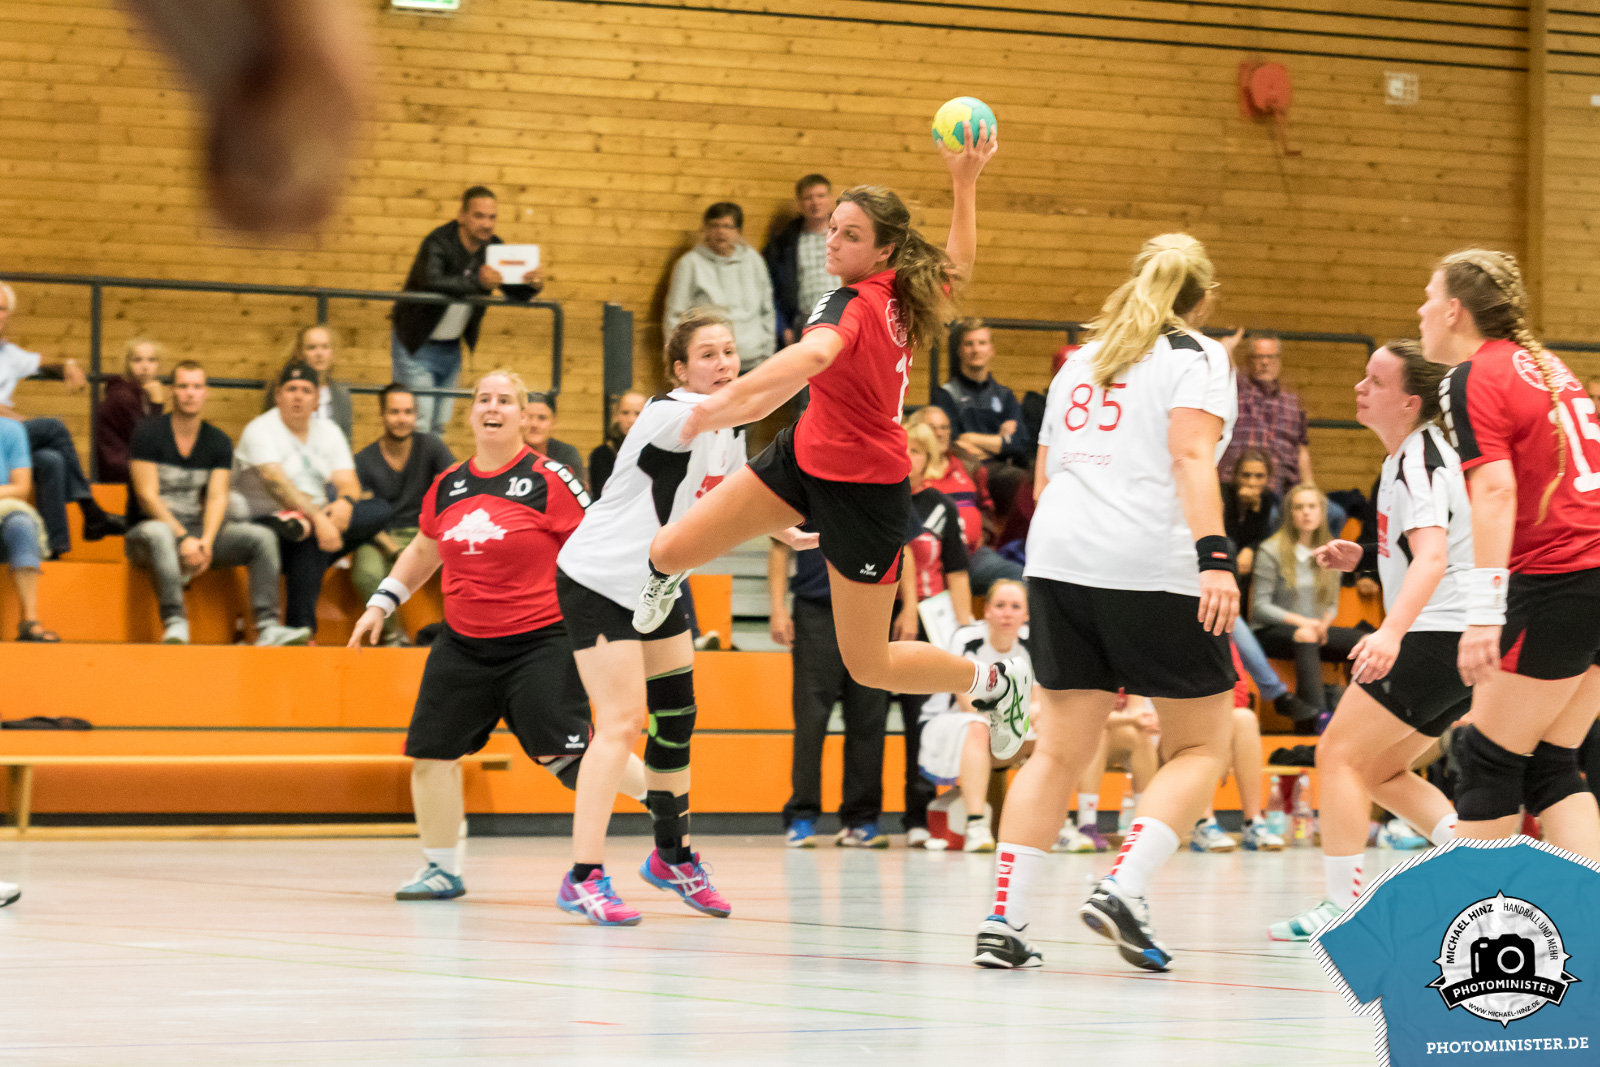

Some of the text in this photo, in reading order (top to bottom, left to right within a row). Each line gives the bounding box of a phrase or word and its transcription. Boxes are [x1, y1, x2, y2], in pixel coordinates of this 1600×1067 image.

[892, 352, 913, 425] 1
[1064, 383, 1127, 432] 85
[1548, 397, 1600, 493] 15
[505, 476, 532, 497] 10
